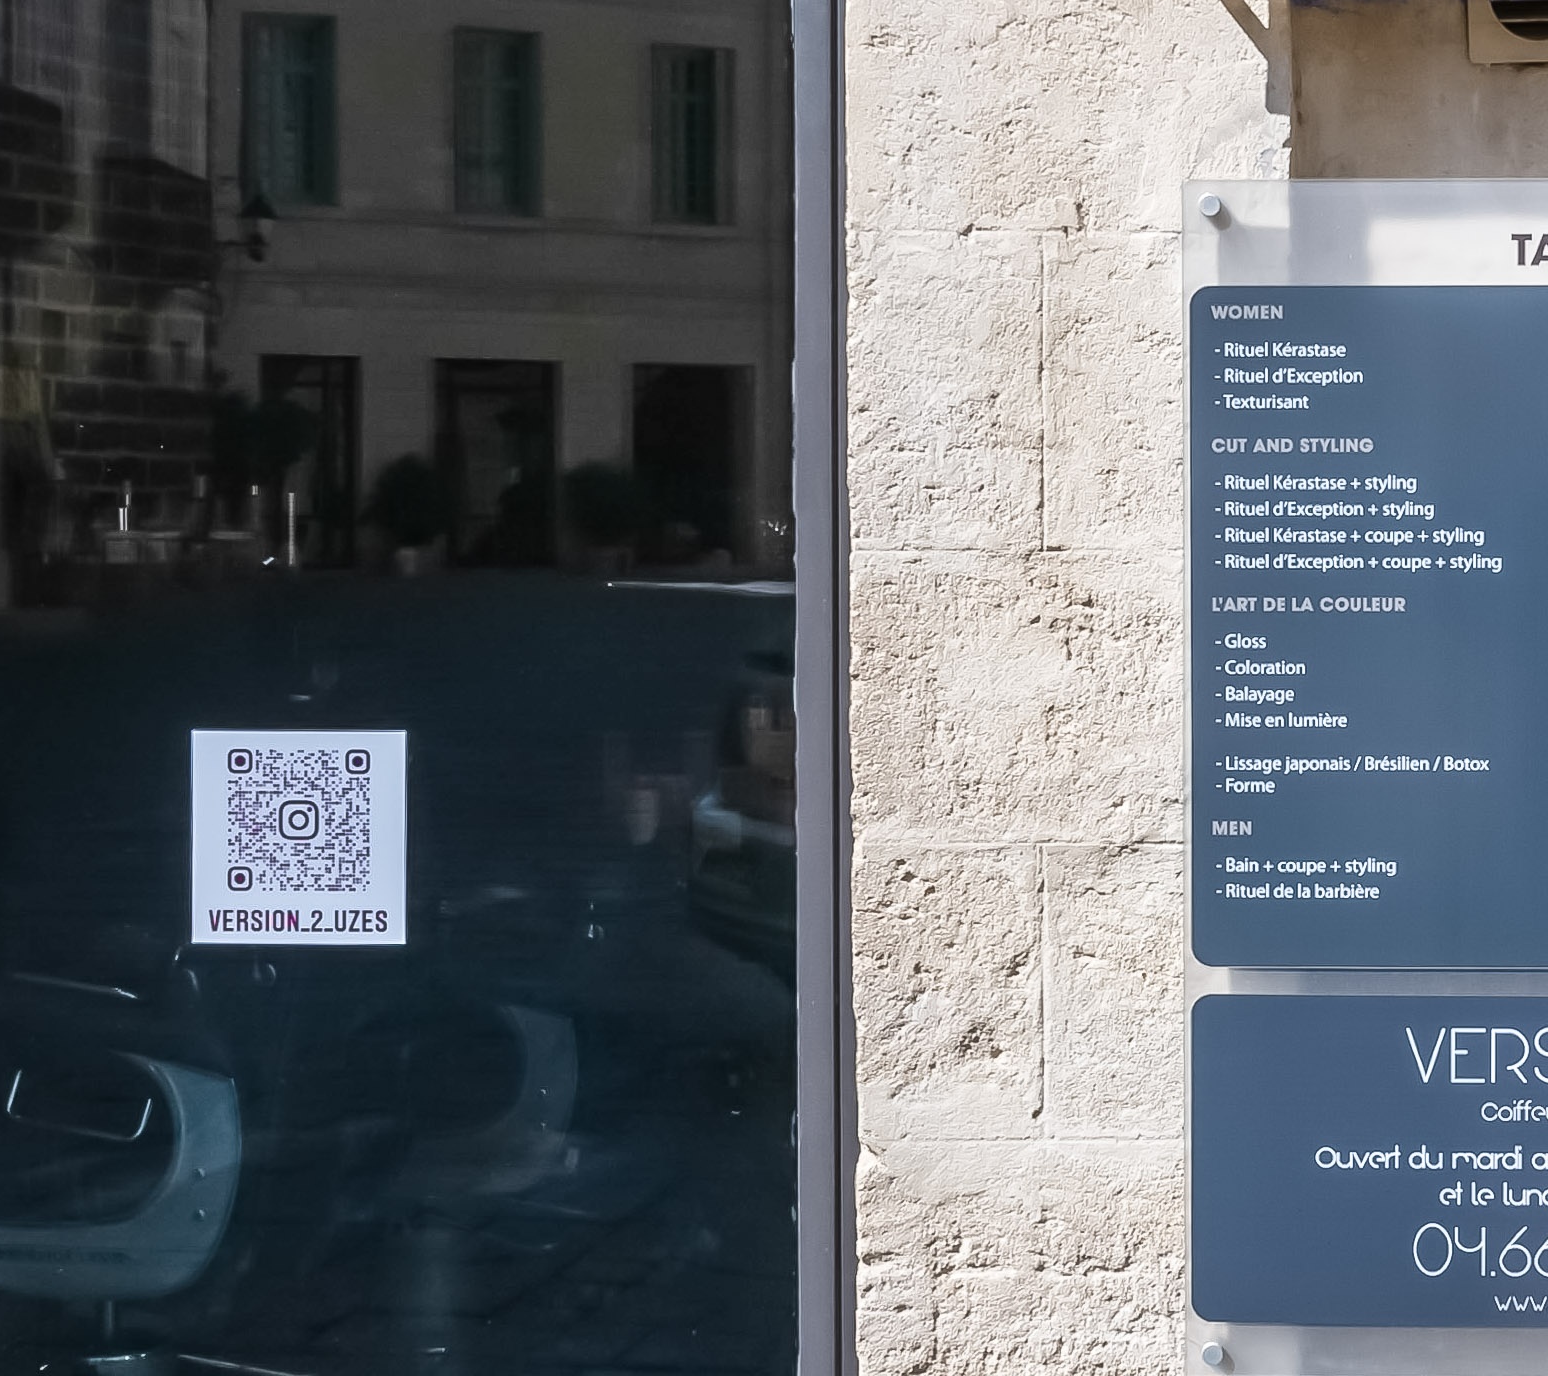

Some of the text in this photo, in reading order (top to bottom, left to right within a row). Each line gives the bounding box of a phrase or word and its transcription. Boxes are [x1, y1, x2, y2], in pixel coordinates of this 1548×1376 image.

[1210, 305, 1283, 320] WOMEN
[1224, 341, 1347, 358] Rituel Kérastase
[1224, 366, 1269, 384] Rituel
[1222, 393, 1310, 410] Texturisant
[1211, 437, 1374, 453] CUT AND STYLING
[1224, 473, 1418, 494] Rituel Kérastase + styling
[1224, 500, 1270, 517] Rituel
[1367, 503, 1379, 516] +
[1382, 500, 1435, 521] styling
[1224, 526, 1485, 547] Rituel Kérastase + coupe + styling
[1224, 553, 1270, 569] Rituel
[1367, 556, 1379, 569] +
[1381, 557, 1432, 573] coupe
[1434, 556, 1447, 569] +
[1449, 552, 1503, 574] styling
[1211, 596, 1406, 612] L'ART DE LA COULEUR
[1224, 632, 1267, 649] Gloss
[1224, 659, 1306, 675] Coloration
[1225, 685, 1295, 705] Balayage
[1224, 711, 1348, 728] Mise en lumière
[1225, 755, 1490, 775] Lissage japonais / Brésilien / Botox
[1225, 777, 1276, 794] Forme
[1212, 820, 1252, 836] MEN
[1225, 856, 1397, 877] Bain + coupe + styling
[1225, 882, 1380, 899] Rituel de la barbière
[208, 909, 388, 933] VERSION_2_UZES
[1314, 1144, 1402, 1169] Ouvert
[1408, 1144, 1444, 1170] du
[1451, 1145, 1523, 1171] mardi
[1439, 1180, 1464, 1206] et
[1470, 1181, 1495, 1206] le
